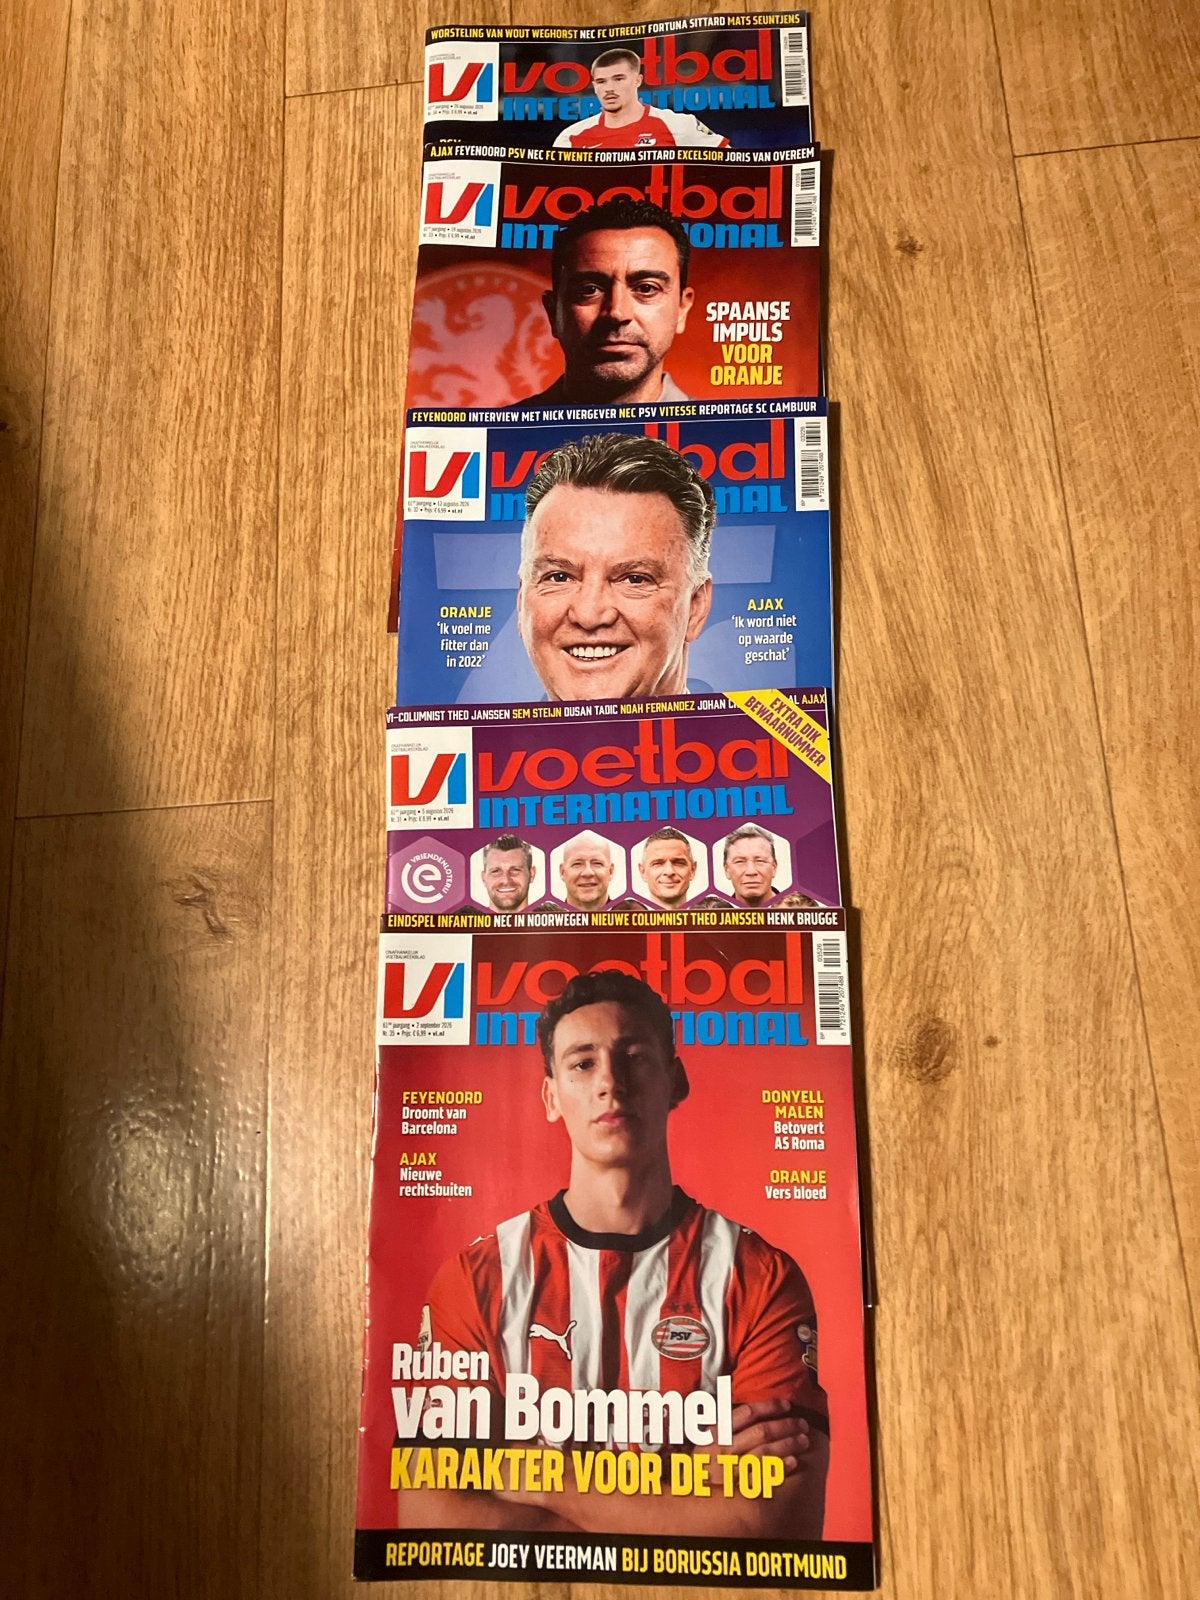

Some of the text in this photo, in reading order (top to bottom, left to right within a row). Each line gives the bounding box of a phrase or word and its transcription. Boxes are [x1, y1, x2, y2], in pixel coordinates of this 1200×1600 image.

[431, 14, 800, 39] WORSTELING VAN WOUT WEGHORST NEC FC UTRECHT FORTUNA SITTARD MATS SEUNTJENS
[503, 29, 773, 93] votbal
[428, 62, 493, 103] VI
[430, 145, 814, 162] AJAX FEYENOORD PSV NEC FC TWENTE FORTUNA SITTARD EXCELSIOR JORIS VAN OVEREEM
[425, 182, 494, 226] VI
[705, 301, 791, 321] SPAANSE
[713, 322, 783, 342] IMPULS
[721, 343, 773, 364] VOOR
[710, 365, 783, 386] ORANJE
[412, 401, 817, 422] FEYENOORD INTERVIEW MET NICK VIERGEVER NEC PSV VITESSE REPORTAGE SC CAMBUUR
[408, 451, 480, 498] VI
[440, 606, 492, 618] ORANJE
[747, 598, 784, 610] AJAX
[451, 622, 473, 634] voel
[474, 625, 491, 634] me
[746, 615, 773, 627] word
[776, 614, 797, 627] niet
[440, 638, 489, 651] fitter dan
[738, 632, 793, 647] op waarde
[446, 655, 457, 667] in
[386, 710, 445, 723] VI-COLUMNIST
[447, 710, 469, 720] THEO
[471, 709, 510, 721] JANSSEN
[512, 708, 530, 719] SEM
[532, 707, 562, 718] STEIJN
[564, 706, 592, 717] DUSAN
[594, 704, 618, 715] TADIC
[620, 703, 643, 714] NOAH
[645, 701, 695, 713] FERNANDEZ
[697, 699, 726, 711] JOHAN
[801, 694, 826, 704] AJAX
[769, 697, 821, 743] EXTRA DIK
[744, 695, 826, 767] BEWAARNUMMER
[478, 717, 789, 792] voetbal
[391, 753, 466, 806] VI
[478, 784, 794, 829] INTERNATIONAL
[387, 912, 838, 928] EINDSPEL INFANTINO NEC IN NOORWEGEN NIEUWE COLUMNIST THEO JANSSEN HENK BRUGGE
[383, 962, 465, 1018] VI
[402, 1091, 483, 1104] FEYENOORD
[761, 1090, 825, 1103] DONYELL
[402, 1106, 467, 1119] Droomt van
[775, 1105, 824, 1119] MALEN
[401, 1121, 457, 1134] Barcelona
[773, 1121, 825, 1134] Betovert
[774, 1136, 825, 1150] AS Roma
[399, 1152, 437, 1165] AJAX
[400, 1167, 442, 1181] Nieuwe
[770, 1169, 827, 1184] ORANJE
[399, 1182, 472, 1196] rechtsbuiten
[765, 1185, 827, 1199] Vers bloed
[670, 1331, 692, 1341] PSV
[392, 1341, 490, 1381] Ruben
[391, 1384, 491, 1440] van
[504, 1373, 733, 1446] Bommel
[389, 1447, 785, 1499] KARAKTER VOOR DE TOP
[385, 1542, 847, 1580] REPORTAGE JOEY VEERMAN BIJ BORUSSIA DORTMUND
